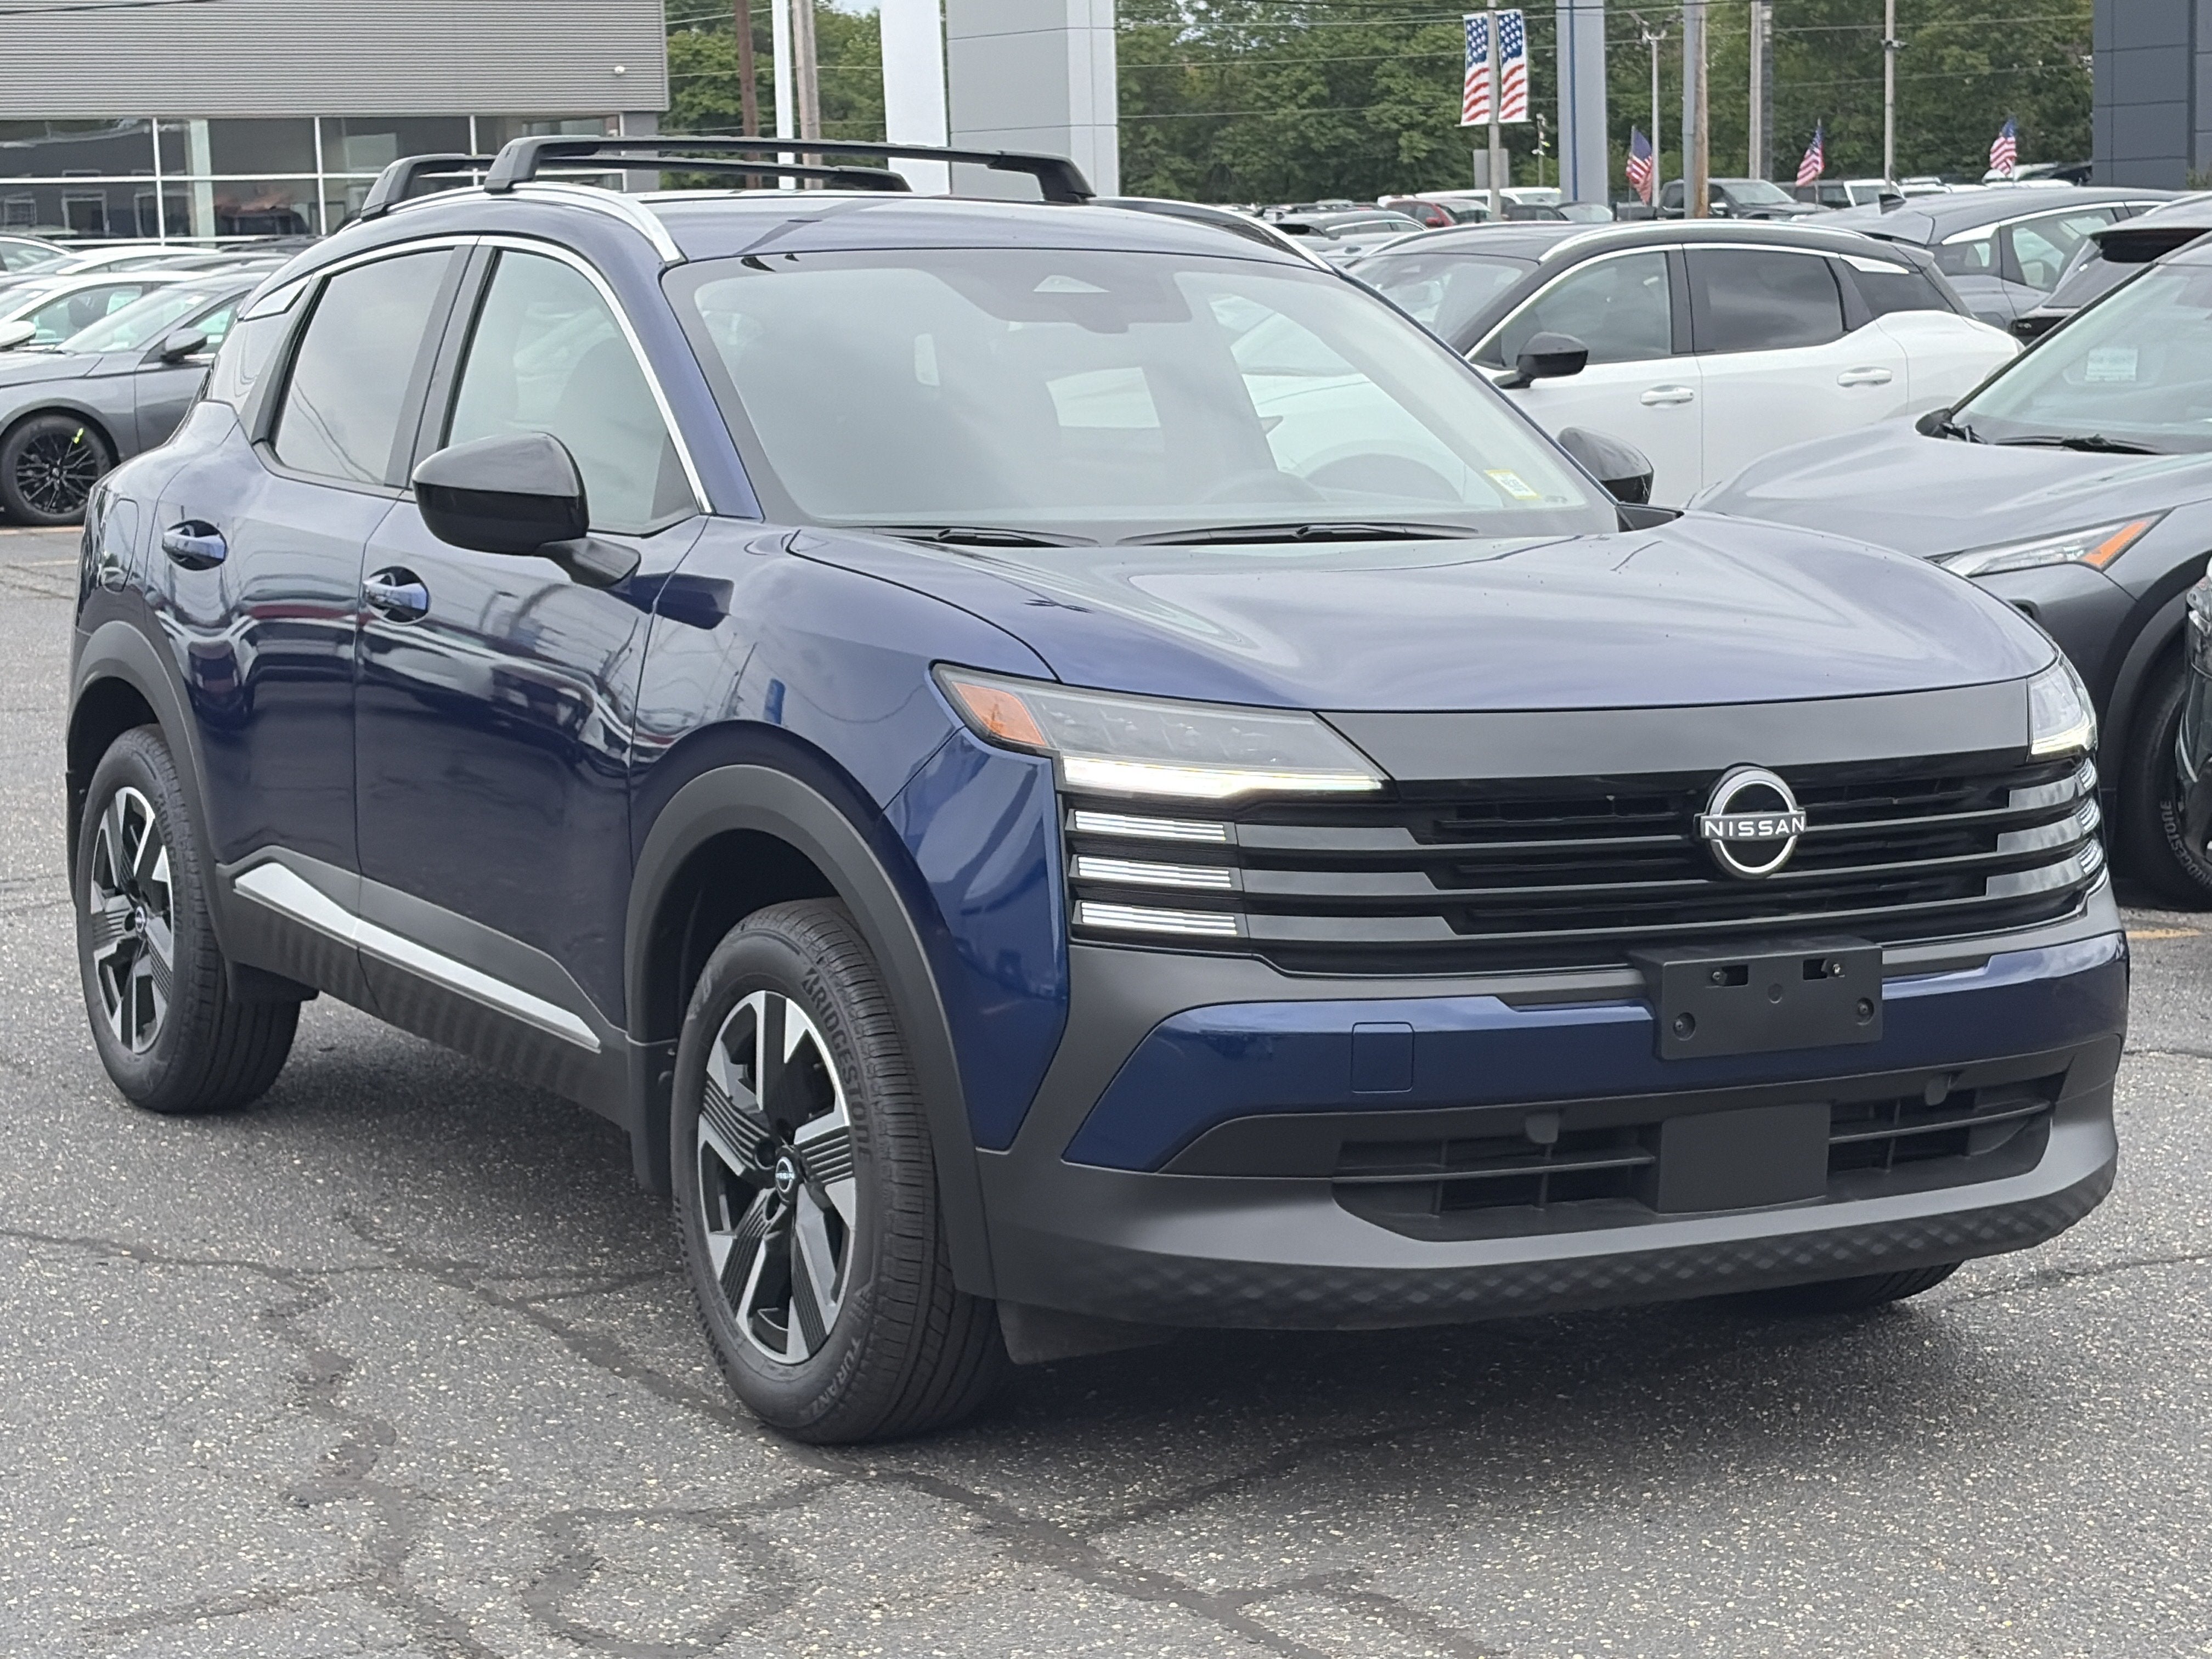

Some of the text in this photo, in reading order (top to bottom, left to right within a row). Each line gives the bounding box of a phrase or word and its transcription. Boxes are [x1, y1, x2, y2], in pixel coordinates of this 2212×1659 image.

[1705, 816, 1805, 837] NISSAN
[2160, 800, 2212, 887] RIDGESTONE
[801, 967, 871, 1162] BRIDGESTONE
